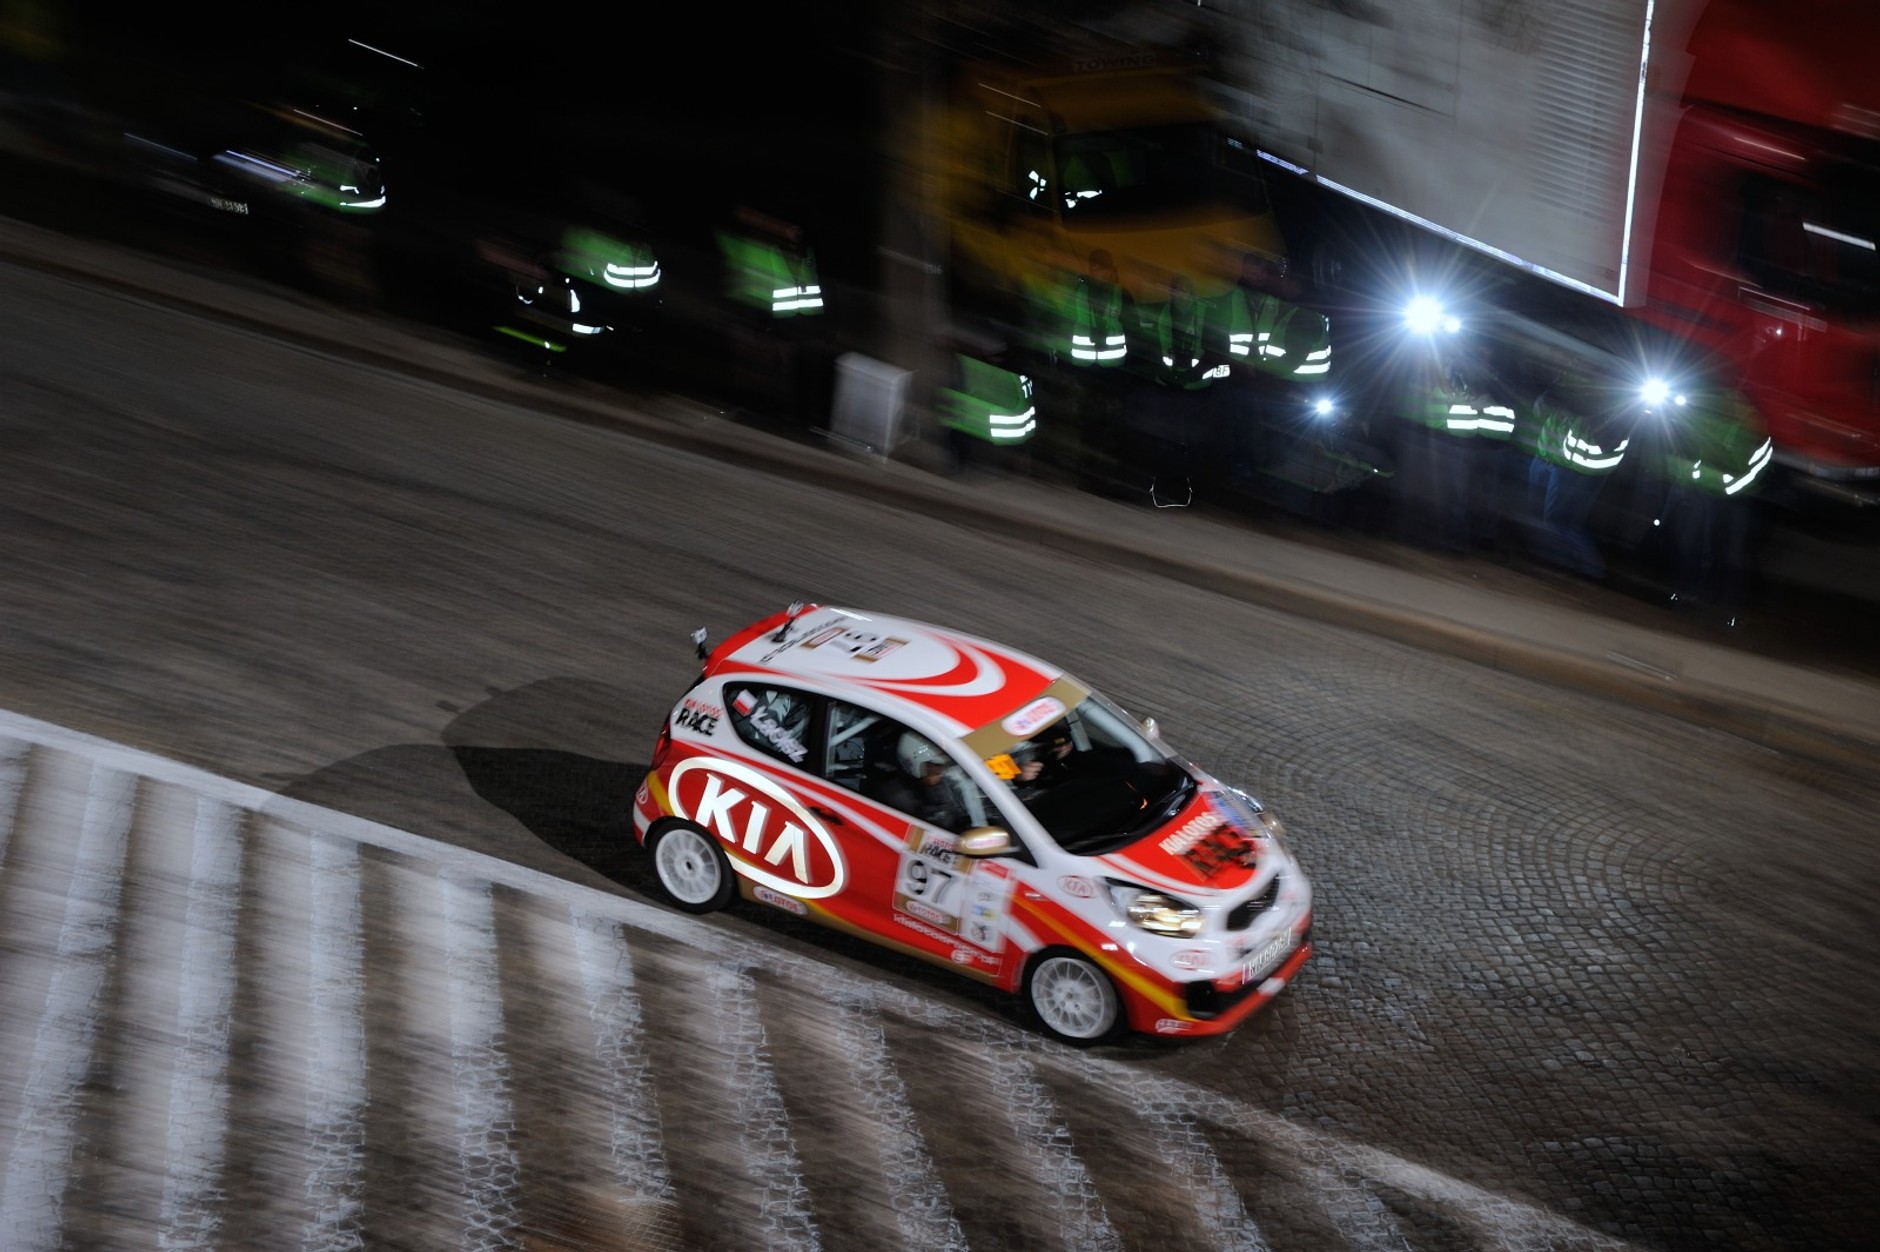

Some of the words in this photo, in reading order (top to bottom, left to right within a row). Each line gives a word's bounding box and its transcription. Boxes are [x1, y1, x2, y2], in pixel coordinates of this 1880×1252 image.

[1074, 54, 1155, 70] TOWING
[675, 707, 718, 737] RACE
[694, 772, 811, 885] KIA
[906, 859, 953, 905] 97
